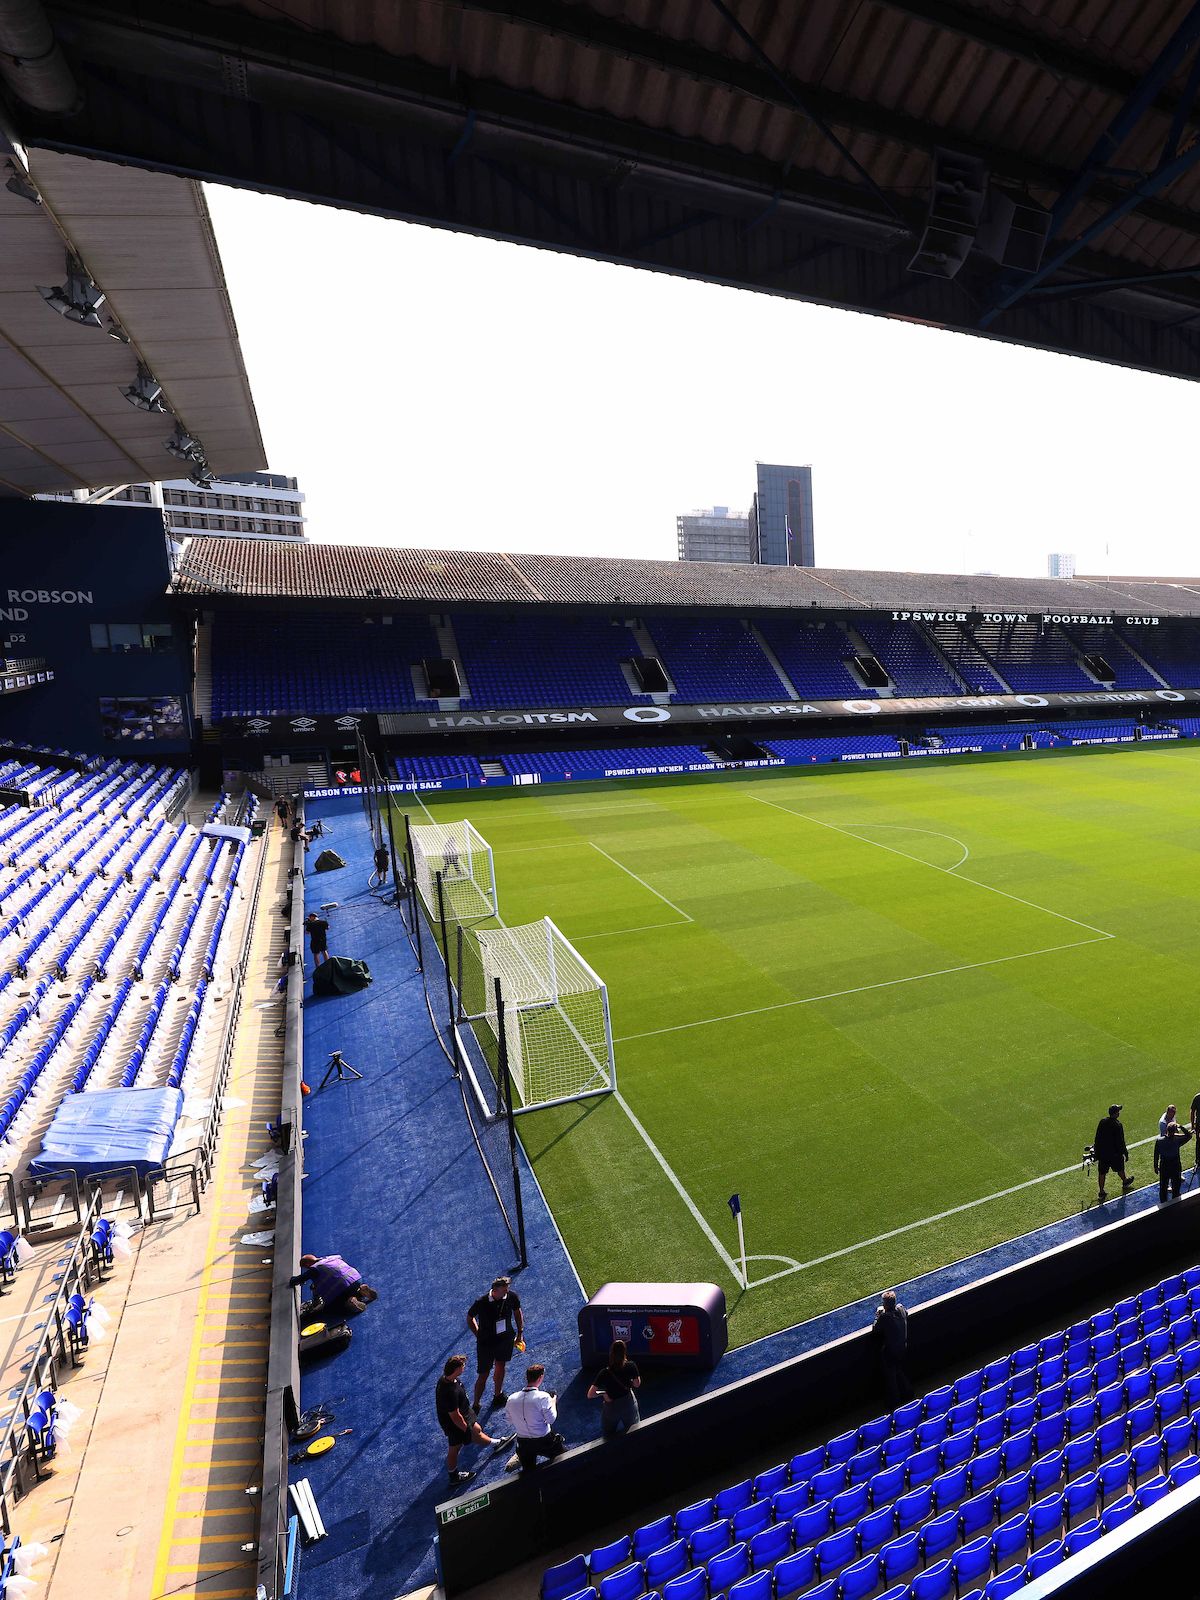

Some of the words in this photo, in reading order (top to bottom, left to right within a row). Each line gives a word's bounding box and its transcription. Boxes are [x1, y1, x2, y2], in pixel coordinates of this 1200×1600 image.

[8, 590, 94, 604] ROBSON
[892, 612, 967, 621] IPSWICH
[983, 614, 1028, 622] TOWN
[1043, 615, 1114, 624] FOOTBALL
[1126, 616, 1160, 625] CLUB
[10, 634, 26, 642] D2
[895, 698, 1004, 709] HALOCRM
[1059, 692, 1149, 703] HALOITSM
[697, 704, 822, 717] HALOPSA
[428, 712, 598, 727] HALOITSM
[605, 768, 635, 776] IPSWICH
[658, 765, 683, 773] WOMEN
[689, 763, 714, 771] SEASON
[304, 789, 340, 798] SEASON
[420, 781, 442, 789] SALE
[465, 1503, 479, 1513] exit
